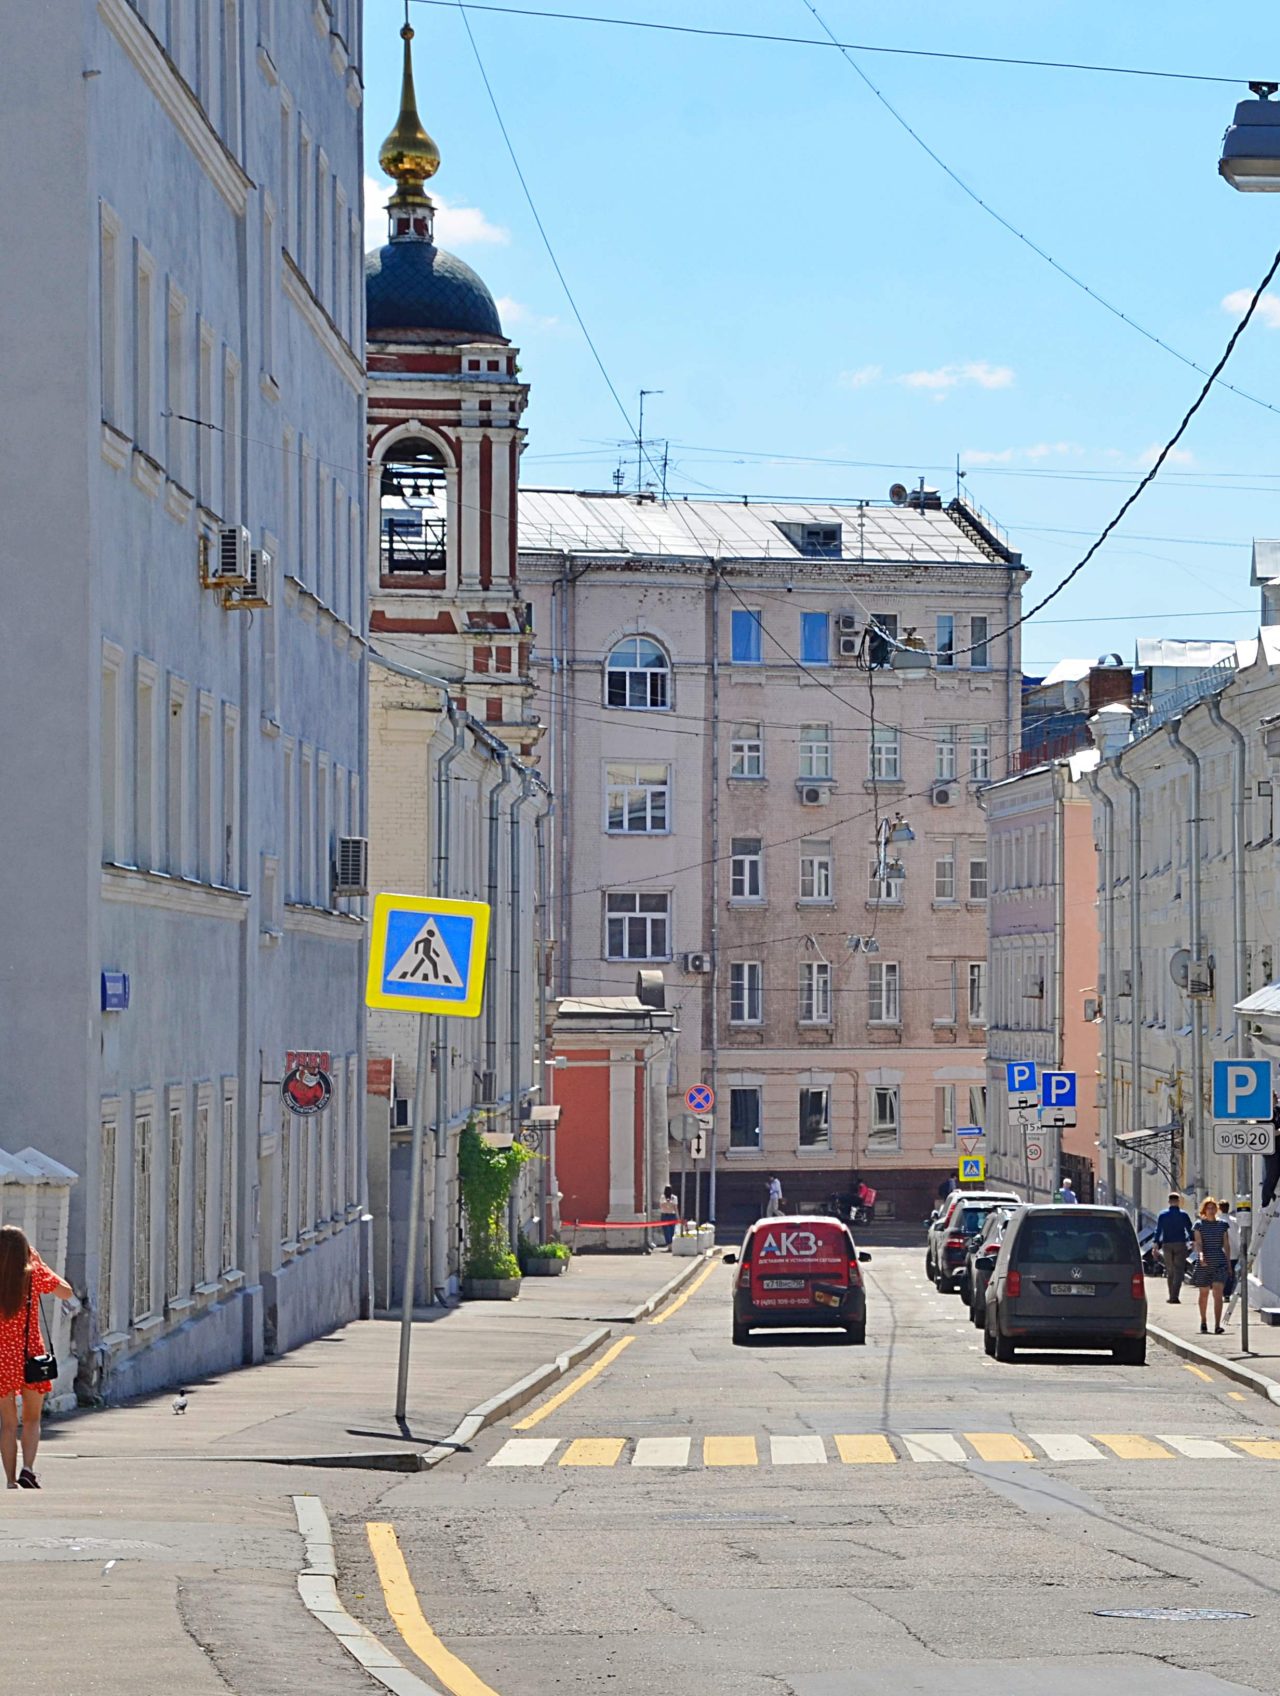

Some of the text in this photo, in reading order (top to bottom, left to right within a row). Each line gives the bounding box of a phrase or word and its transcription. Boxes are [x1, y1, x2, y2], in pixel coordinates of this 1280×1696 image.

[1014, 1065, 1030, 1089] P
[1051, 1075, 1071, 1104] P
[1227, 1066, 1257, 1114] P
[1221, 1132, 1267, 1146] 10 15 20
[1029, 1148, 1039, 1156] 50
